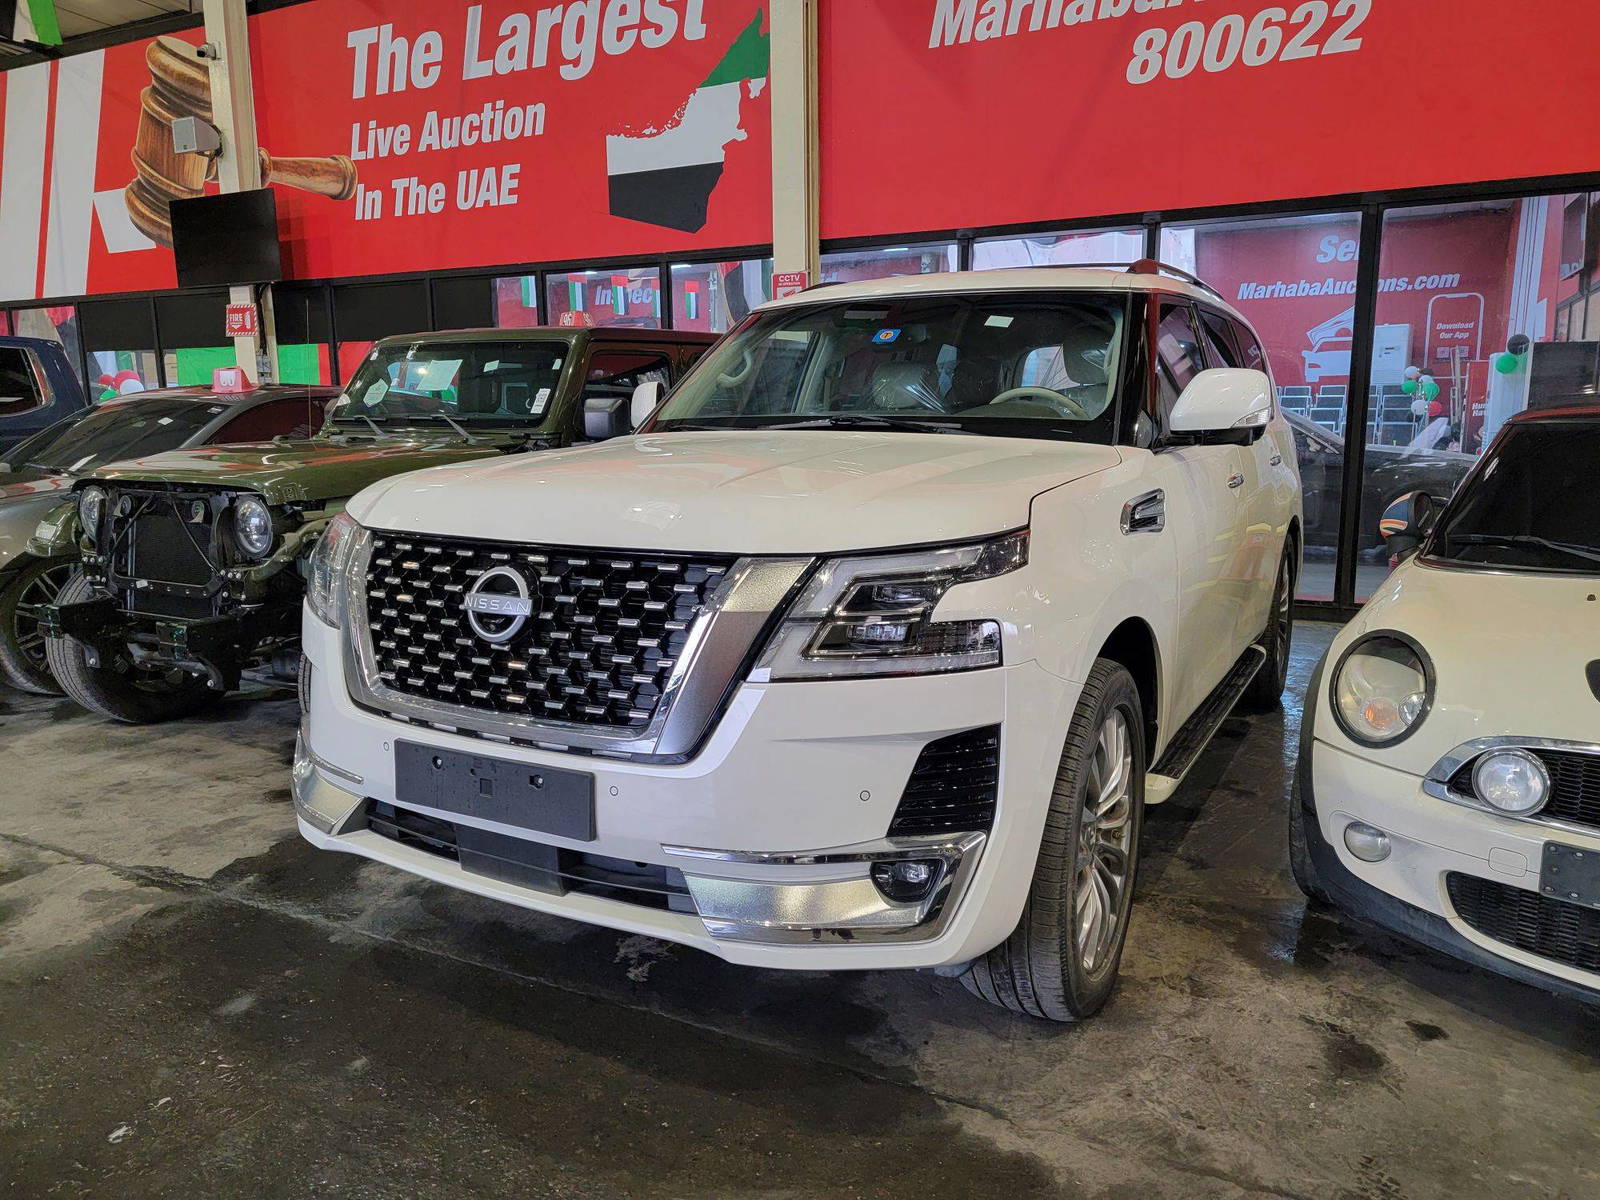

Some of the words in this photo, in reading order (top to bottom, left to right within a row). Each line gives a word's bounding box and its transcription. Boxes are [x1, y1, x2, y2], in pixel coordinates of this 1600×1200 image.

[347, 23, 443, 100] The
[462, 0, 706, 81] Largest
[928, 0, 1206, 49] Marha
[1125, 0, 1373, 85] 800622
[351, 120, 410, 160] Live
[418, 100, 546, 152] Auction
[355, 183, 382, 221] In
[391, 176, 446, 217] The
[456, 163, 521, 210] UAE
[230, 313, 243, 322] FIRE
[1454, 331, 1470, 340] App
[464, 595, 530, 613] NISSAN
